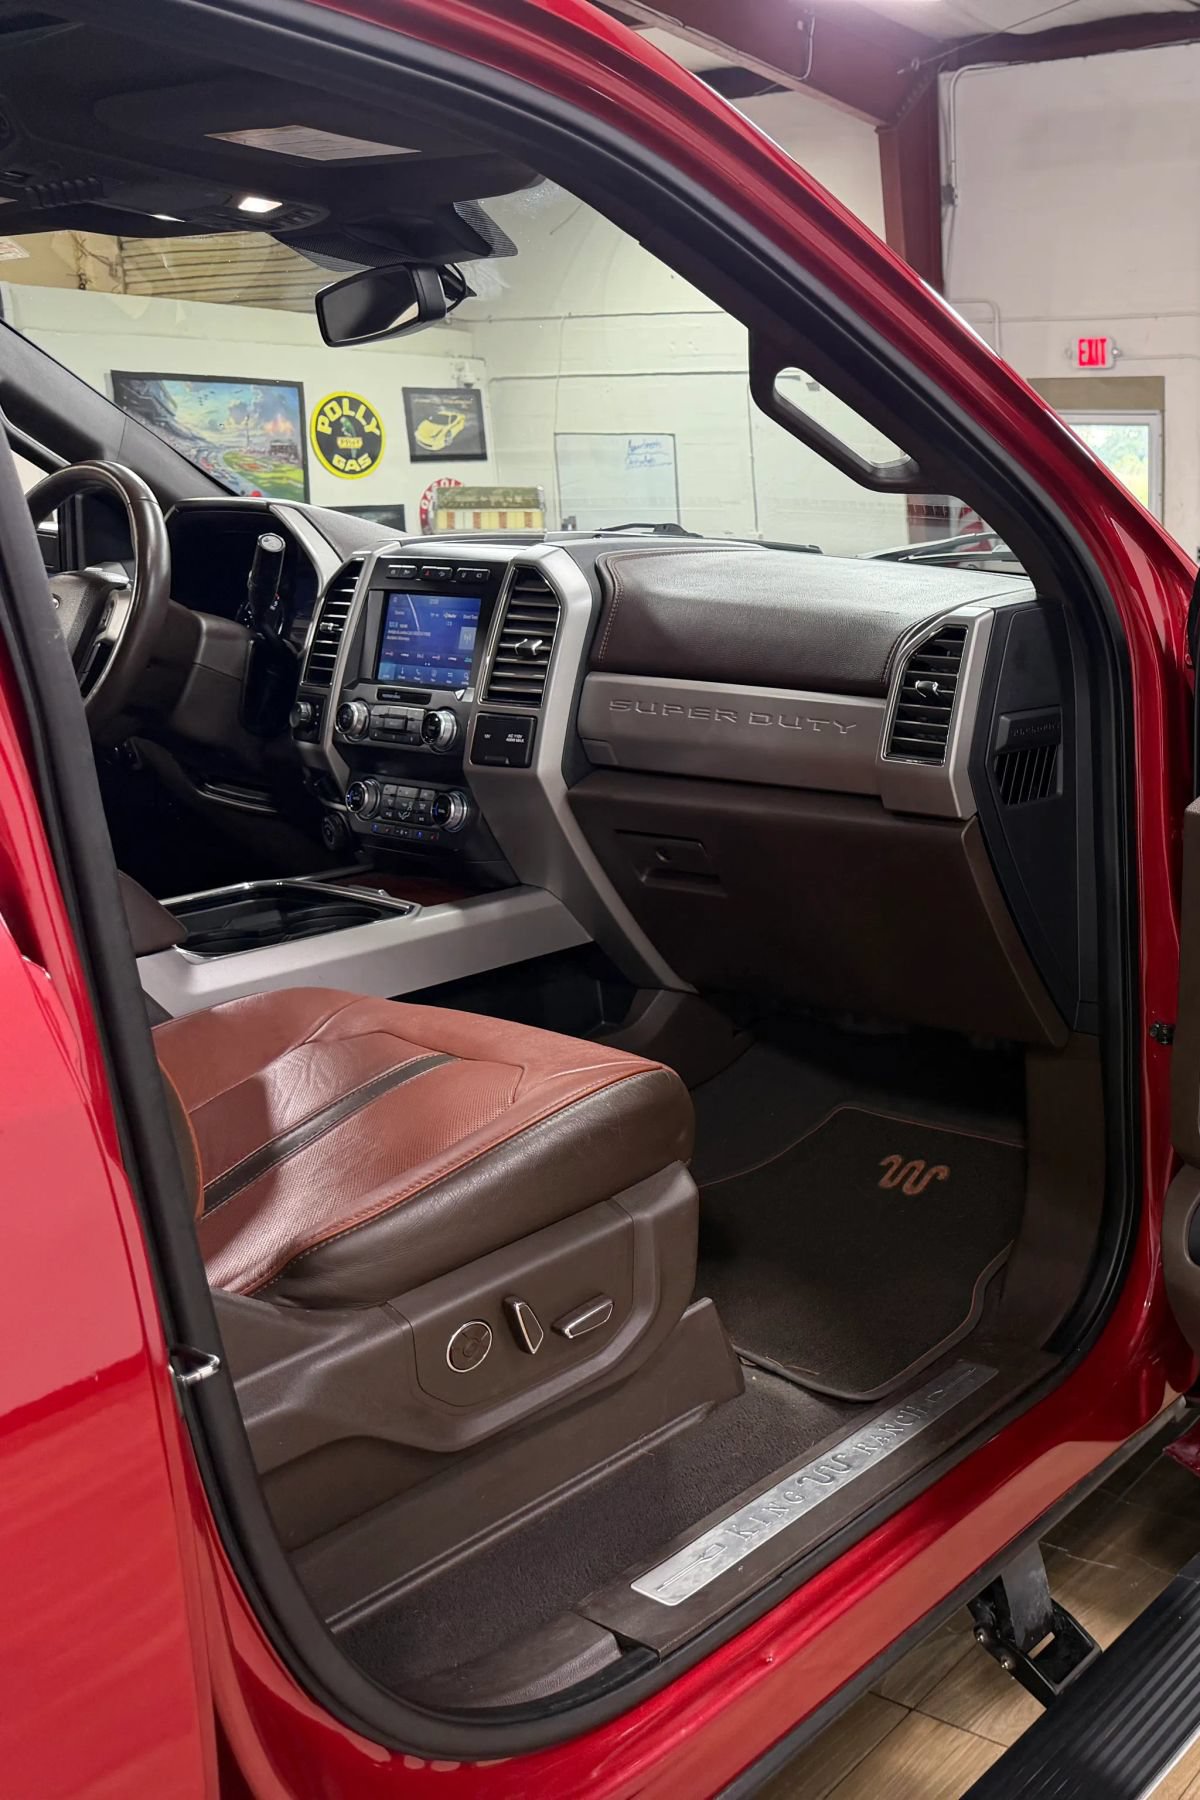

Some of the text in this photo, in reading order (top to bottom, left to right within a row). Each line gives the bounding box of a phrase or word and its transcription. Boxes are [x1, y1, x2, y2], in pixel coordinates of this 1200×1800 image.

[1078, 338, 1107, 366] EXIT
[317, 398, 381, 436] POLLY
[332, 453, 372, 472] GAS
[609, 700, 857, 734] SUPER DUTY
[725, 1404, 930, 1542] KING RANCH
